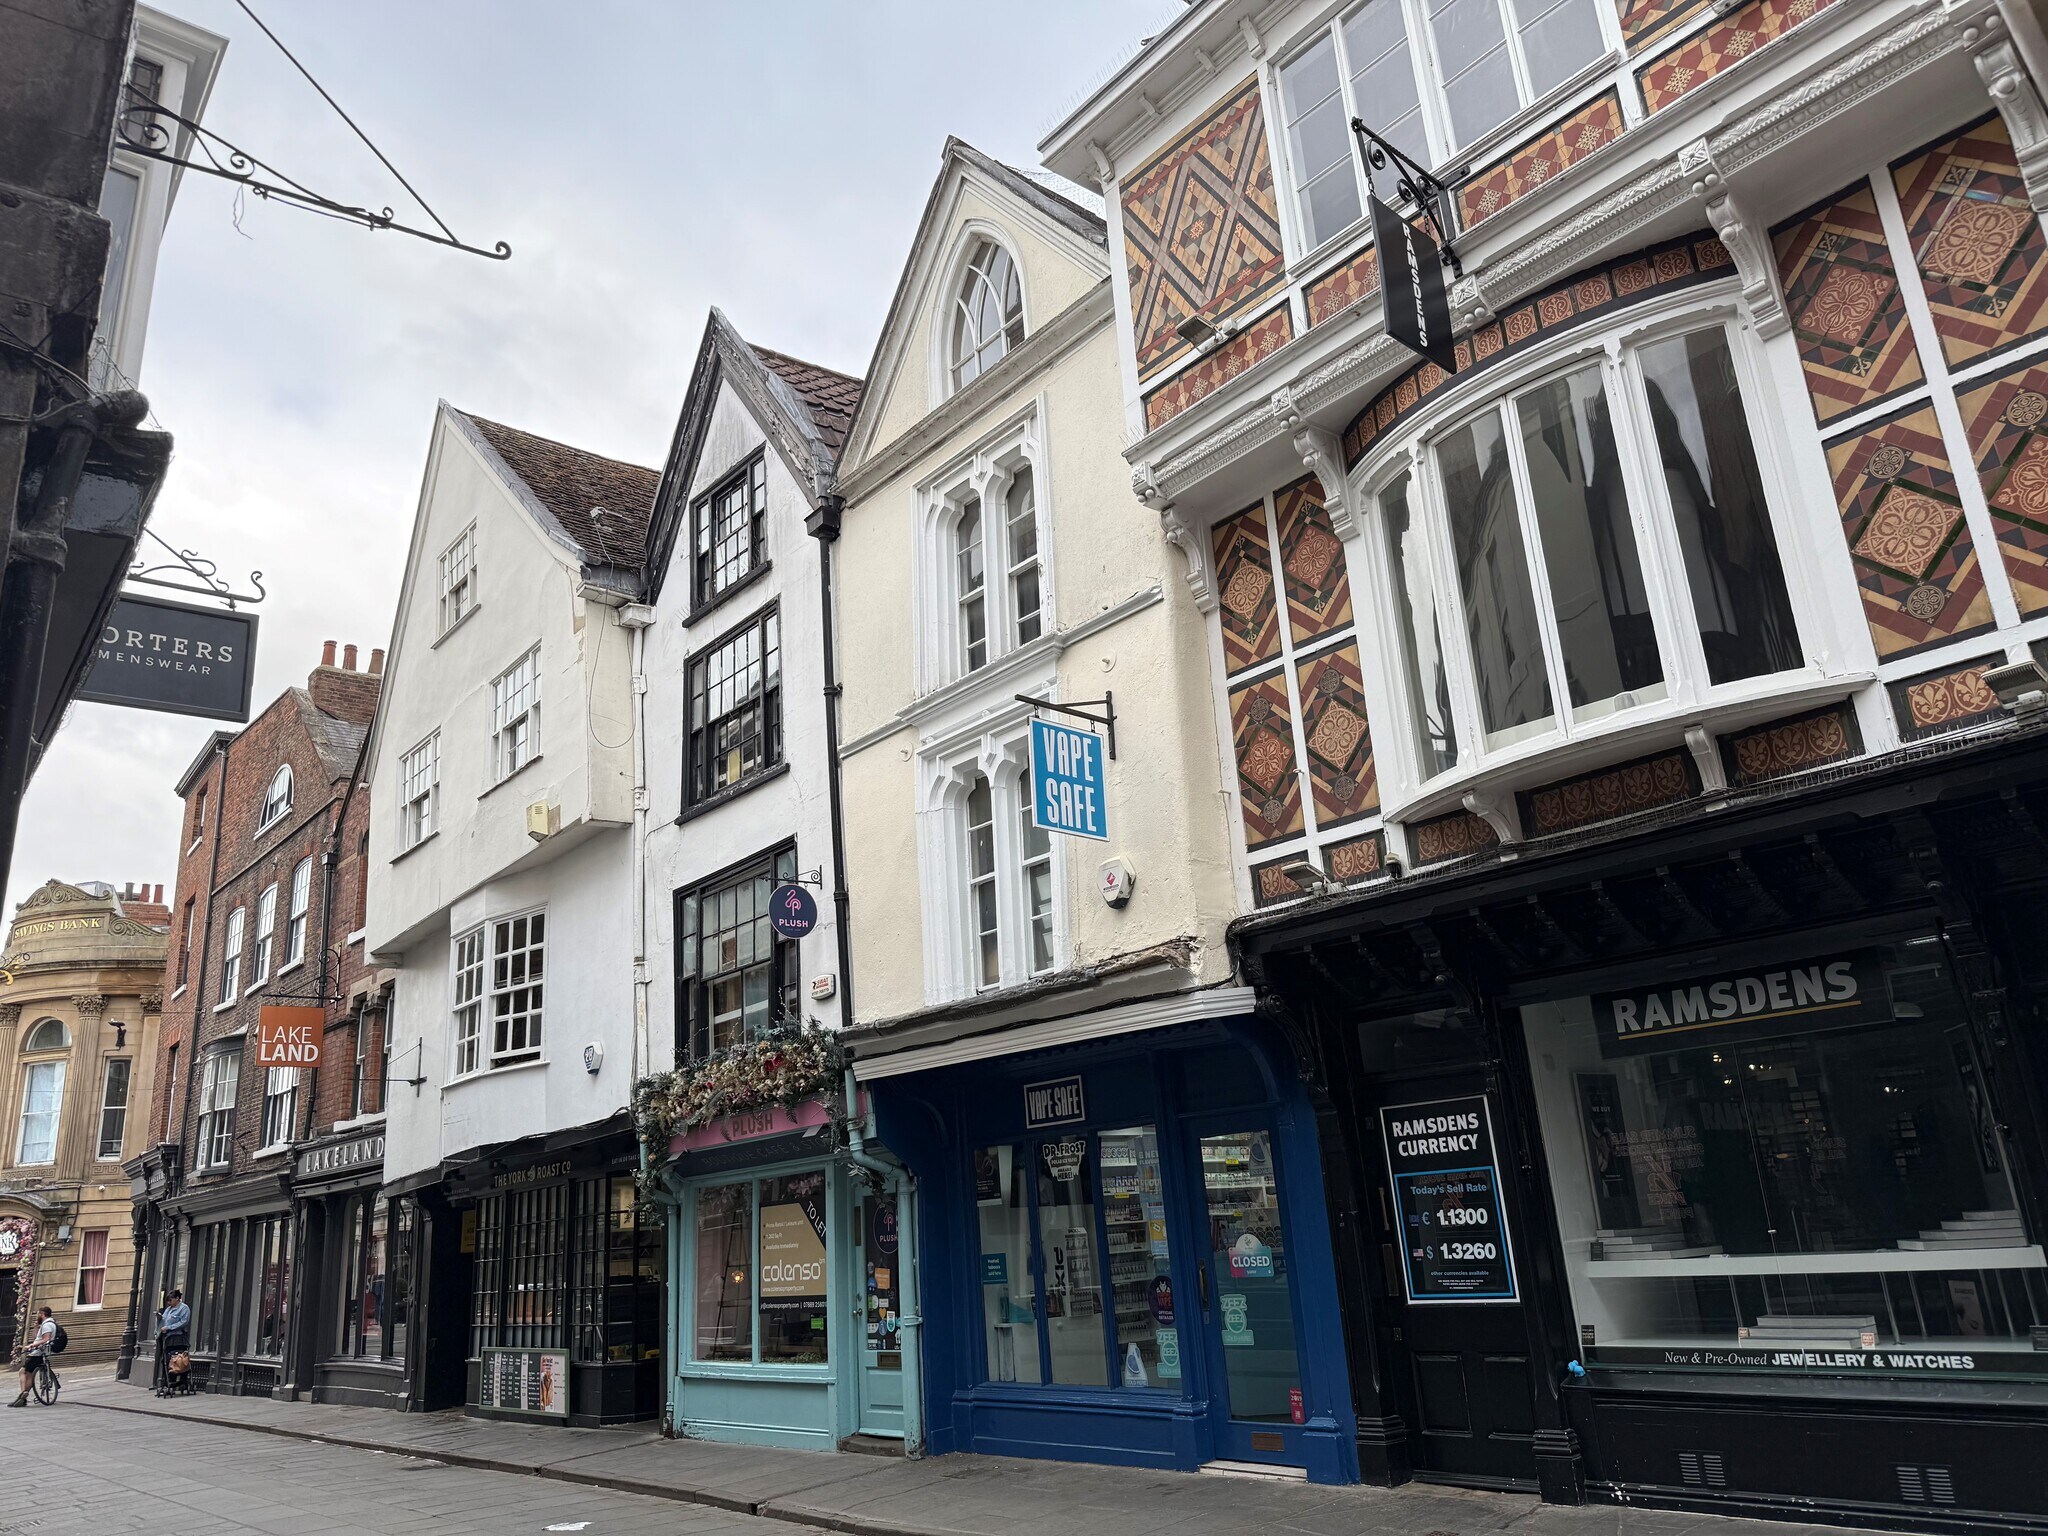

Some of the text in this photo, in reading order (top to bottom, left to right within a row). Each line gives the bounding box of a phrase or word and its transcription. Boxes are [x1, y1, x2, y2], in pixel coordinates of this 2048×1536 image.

[1402, 222, 1428, 347] RAMSDENS
[98, 649, 211, 675] MENSWEAR
[1042, 727, 1094, 782] VAPE
[1045, 777, 1097, 832] SAFE
[14, 918, 102, 939] SAVINGS BANK
[779, 918, 808, 928] PLUSH
[1612, 961, 1858, 1033] RAMSDENS
[261, 1025, 313, 1044] LAKE
[260, 1043, 319, 1062] LAND
[1028, 1084, 1080, 1120] VAPE SAFE
[732, 1113, 774, 1137] PLUSH
[1392, 1112, 1479, 1137] RAMSDENS
[306, 1136, 384, 1173] LAKELAND
[1398, 1133, 1478, 1157] CURRENCY
[494, 1174, 507, 1188] THE
[507, 1169, 526, 1185] YORK
[536, 1162, 561, 1179] ROAST
[1410, 1183, 1487, 1196] Today's Sell Rate
[807, 1201, 827, 1238] TO LET
[1421, 1208, 1488, 1226] € 1.1300
[879, 1234, 897, 1243] PLUSH
[1231, 1255, 1270, 1268] CLOSED
[1426, 1242, 1496, 1260] $ 1.3260
[762, 1259, 821, 1282] colenso
[1664, 1352, 1975, 1369] New & Pre-Owned JEWELLERY & WATCHES
